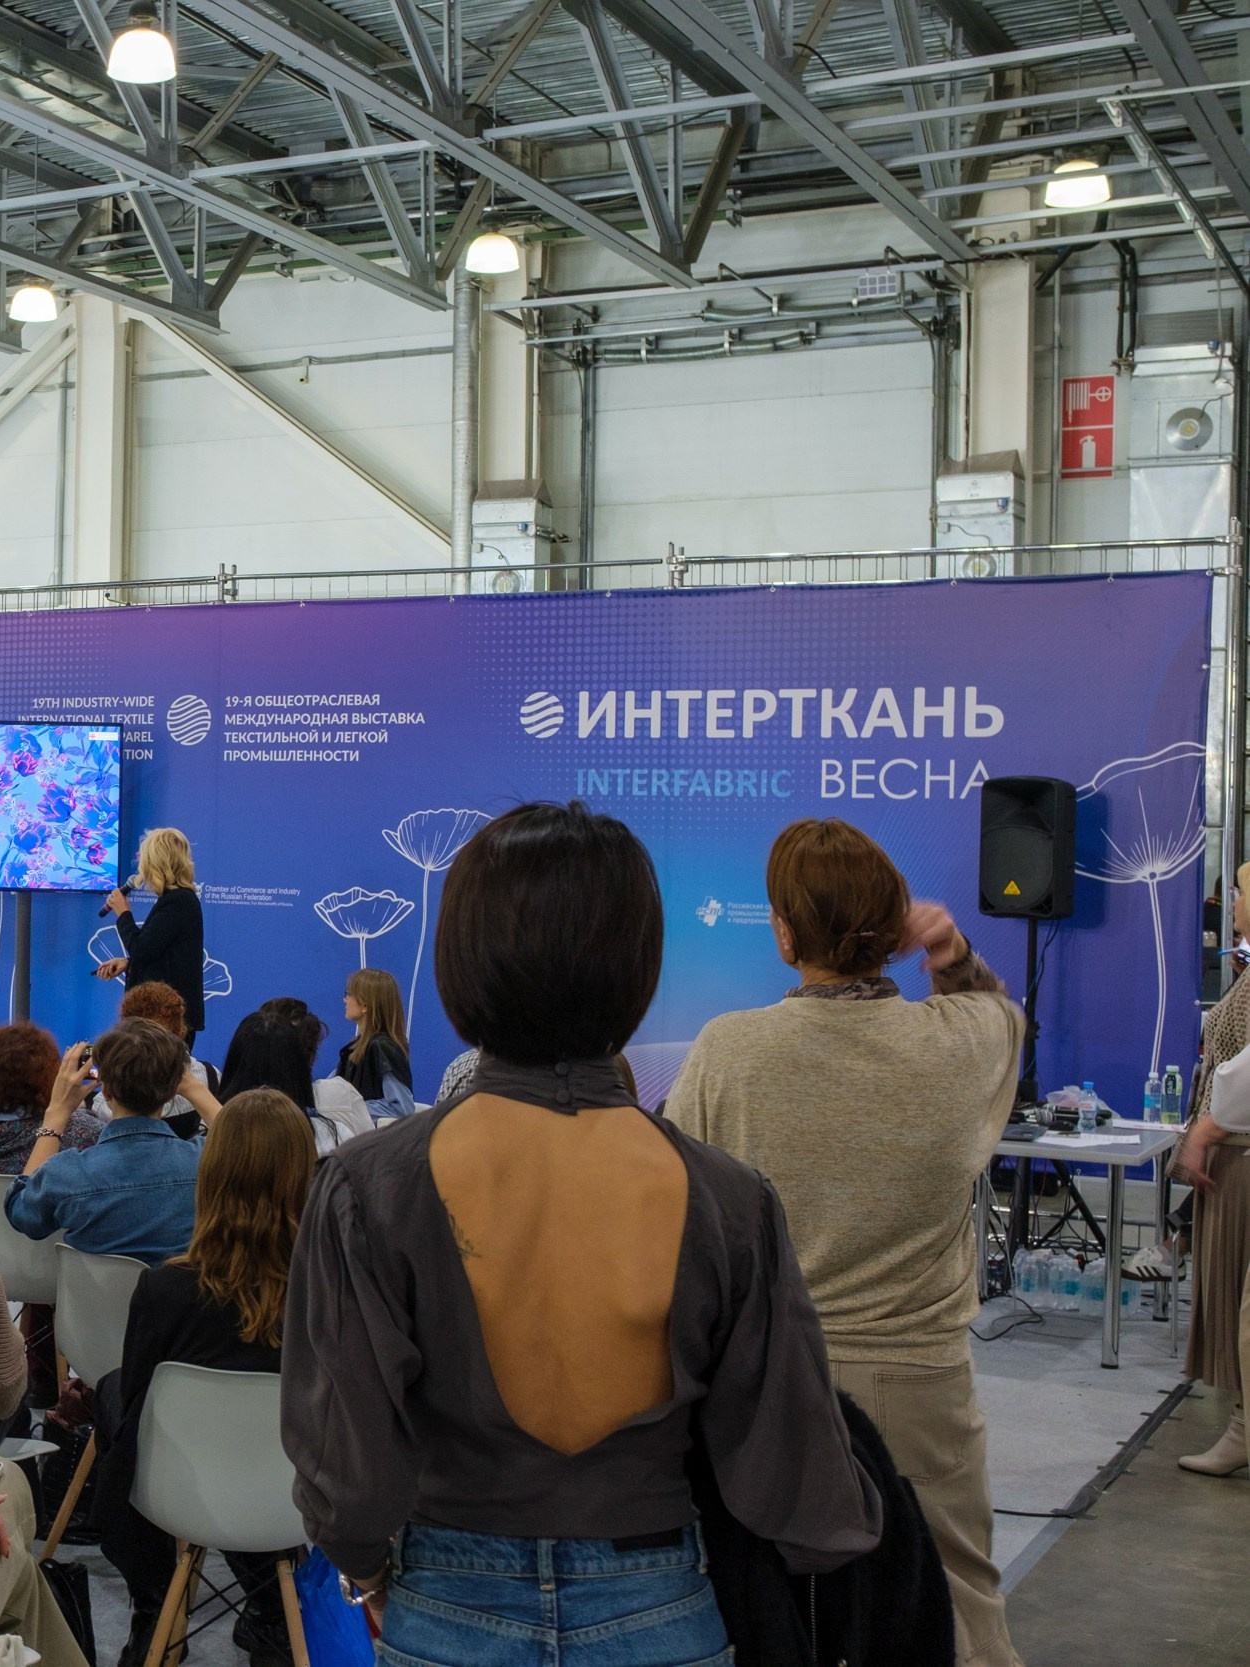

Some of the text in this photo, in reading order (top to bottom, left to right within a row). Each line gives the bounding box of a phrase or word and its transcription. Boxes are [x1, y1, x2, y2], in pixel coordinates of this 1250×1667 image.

[32, 695, 155, 709] 19TH INDUSTRY-WIDE
[225, 694, 381, 708] 19-Я ОБЩЕОТРАСЛЕВАЯ
[110, 713, 154, 725] TEXTILE
[224, 712, 426, 727] МЕЖДУНАРОДНАЯ ВЫСТАВКА
[578, 686, 1005, 739] ИНТЕРТКАНЬ
[224, 729, 389, 743] ТЕКСТИЛЬНОЙ И ЛЕГКОЙ
[223, 750, 360, 762] ПРОМЫШЛЕННОСТИ
[576, 768, 792, 798] INTERFABRIC
[820, 758, 990, 800] ВЕСНА
[205, 885, 229, 893] Chamber
[236, 886, 266, 894] Commerce
[278, 888, 301, 896] Industry
